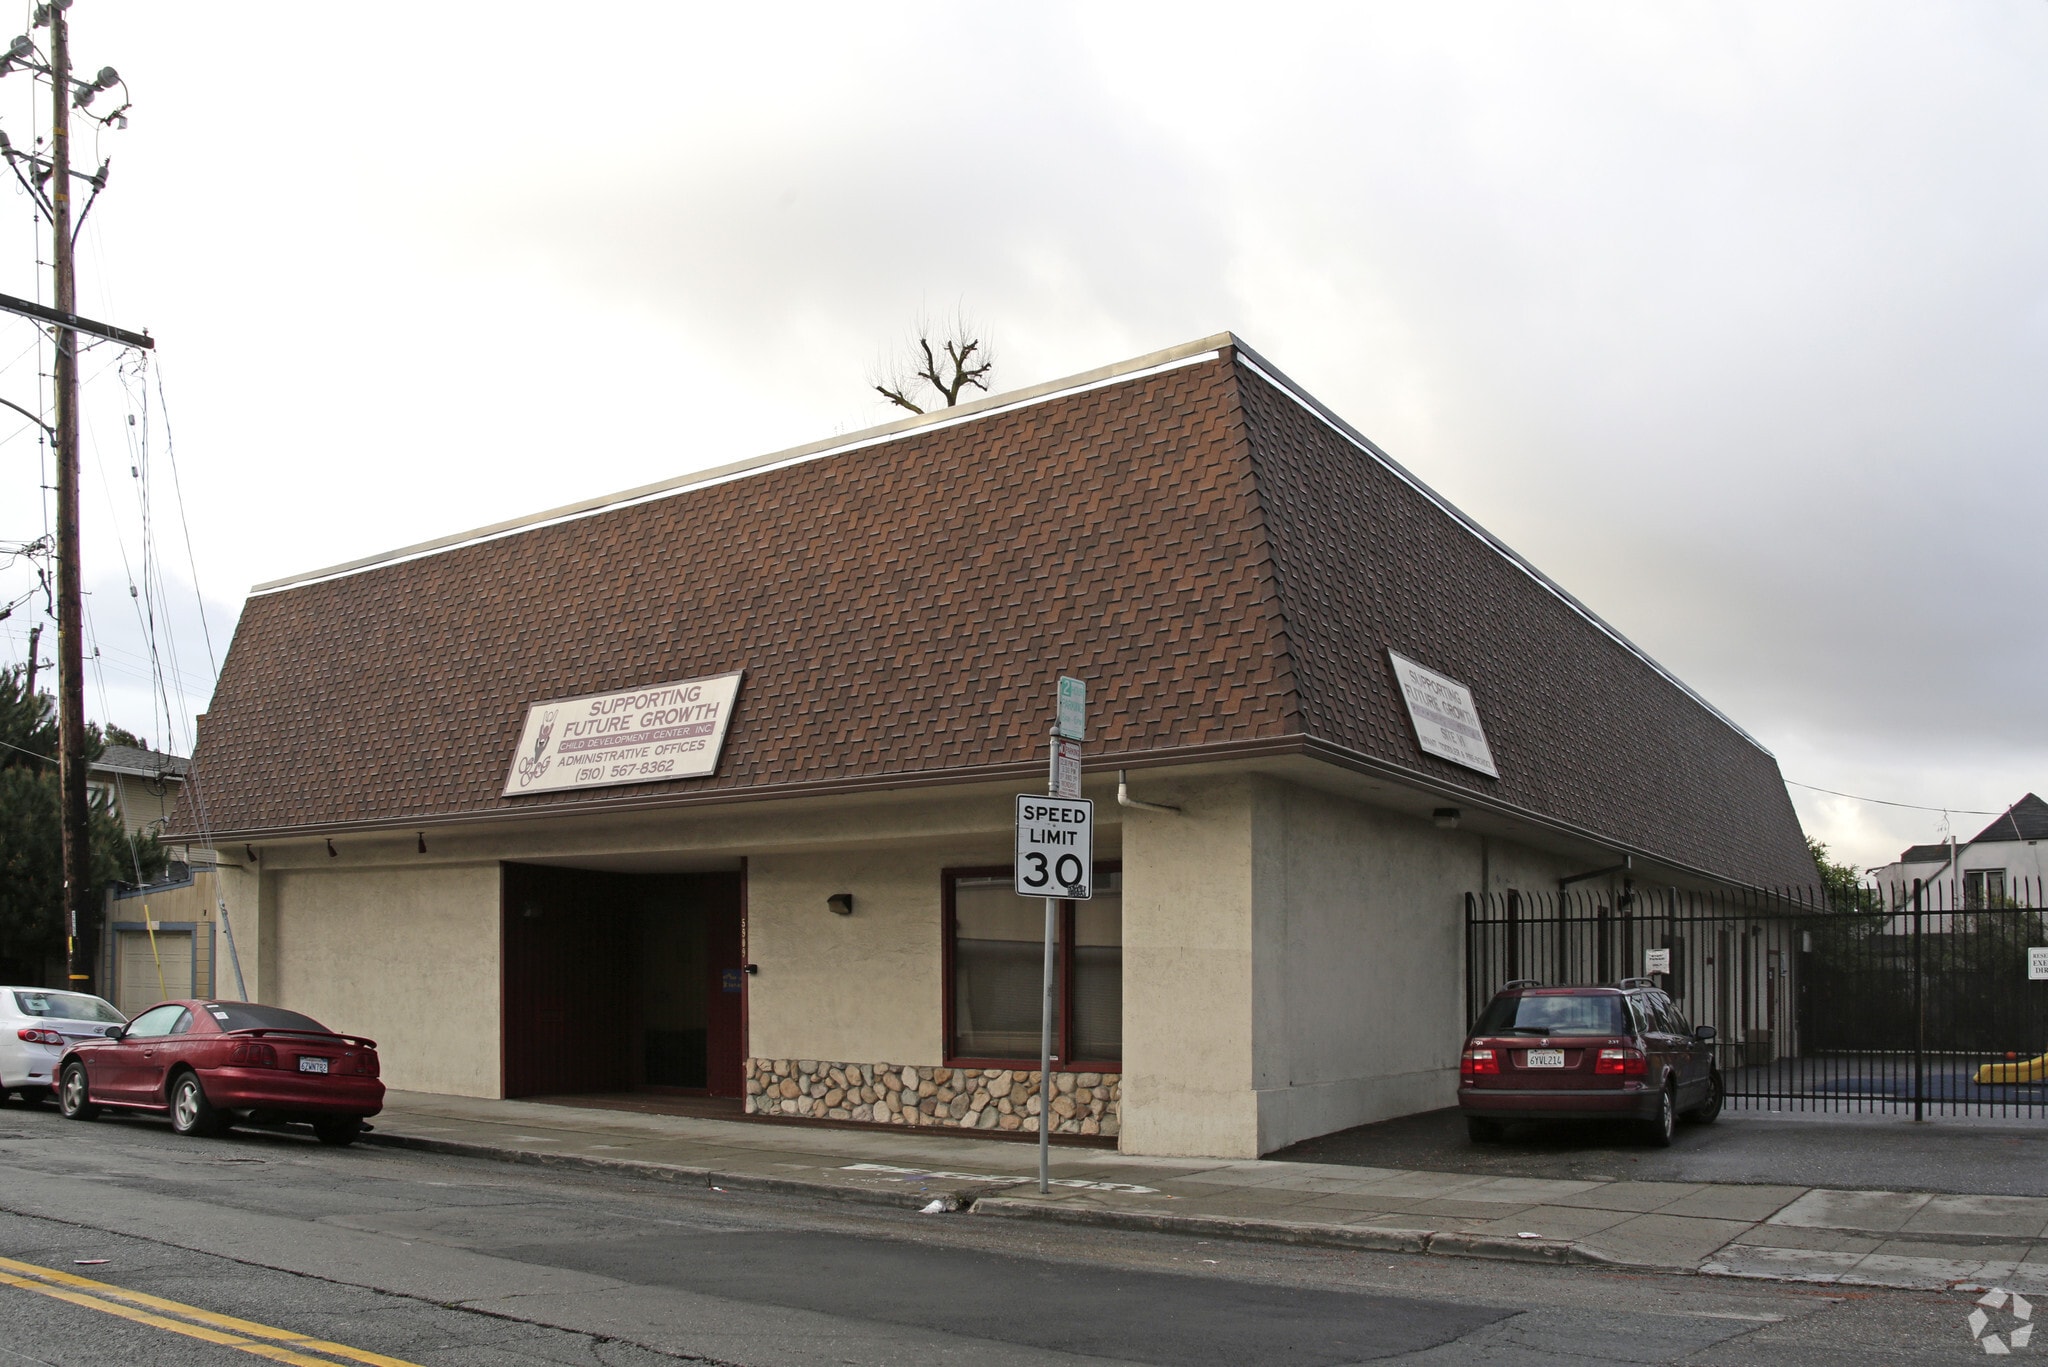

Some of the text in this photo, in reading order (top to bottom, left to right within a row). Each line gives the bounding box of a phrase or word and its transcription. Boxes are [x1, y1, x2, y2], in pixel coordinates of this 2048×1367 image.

[1064, 680, 1070, 695] 2
[1409, 669, 1461, 705] SUPPORTING
[589, 686, 702, 717] SUPPORTING
[1404, 683, 1440, 711] FUTURE
[1442, 701, 1479, 728] GROWTH
[563, 702, 720, 738] FUTURE GROWTH
[557, 739, 706, 768] ADMINISTRATIVE OFFICES
[560, 740, 584, 753] CHILD
[587, 732, 650, 748] DEVELOPMENT
[576, 759, 674, 783] (510) 567-8362
[1024, 805, 1086, 824] SPEED
[1030, 828, 1078, 846] LIMIT
[1023, 852, 1083, 889] 30
[1530, 1055, 1562, 1065] 6YVL214
